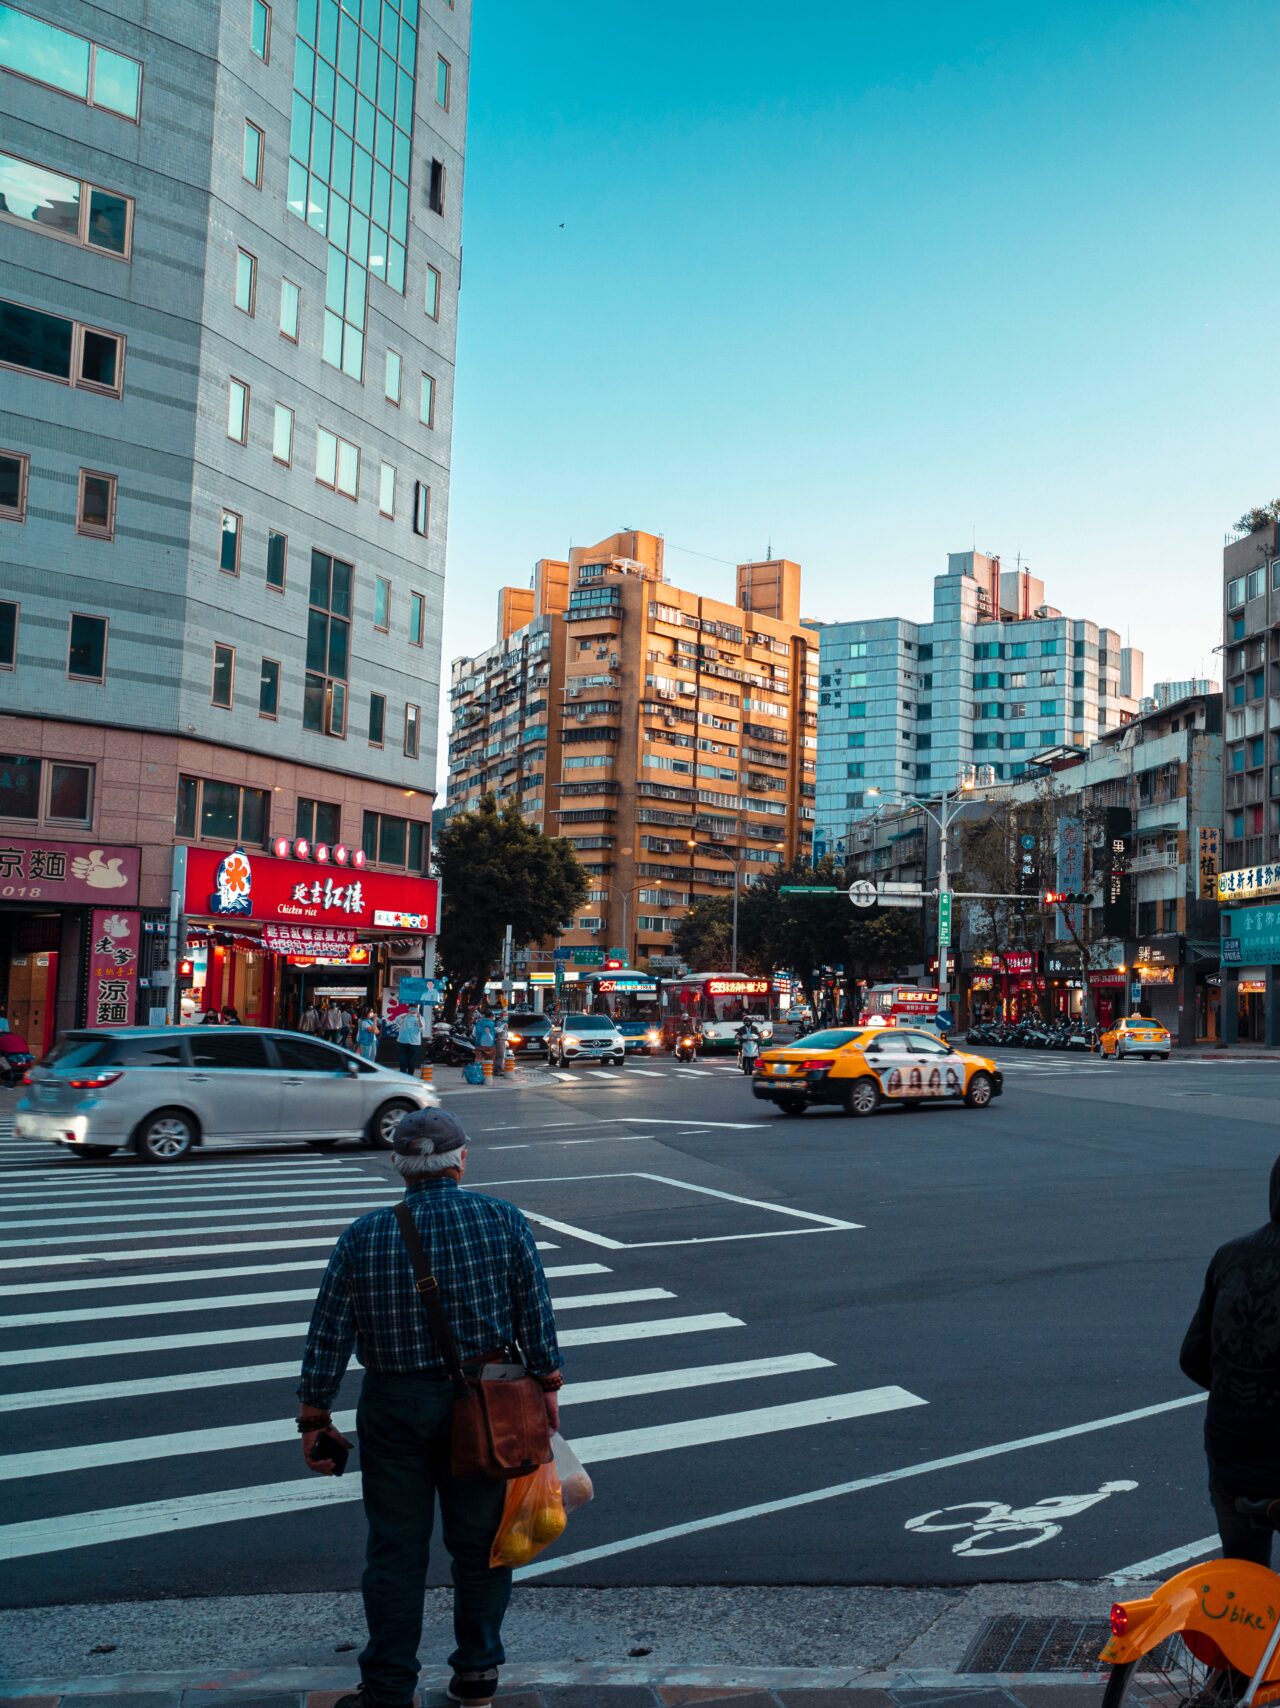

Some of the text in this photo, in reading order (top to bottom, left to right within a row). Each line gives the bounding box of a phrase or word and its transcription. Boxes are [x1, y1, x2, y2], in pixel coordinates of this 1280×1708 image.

[1200, 857, 1217, 898] 植牙
[277, 903, 317, 917] Chicken rice
[599, 981, 616, 992] 257
[97, 980, 130, 1025] 涼麵
